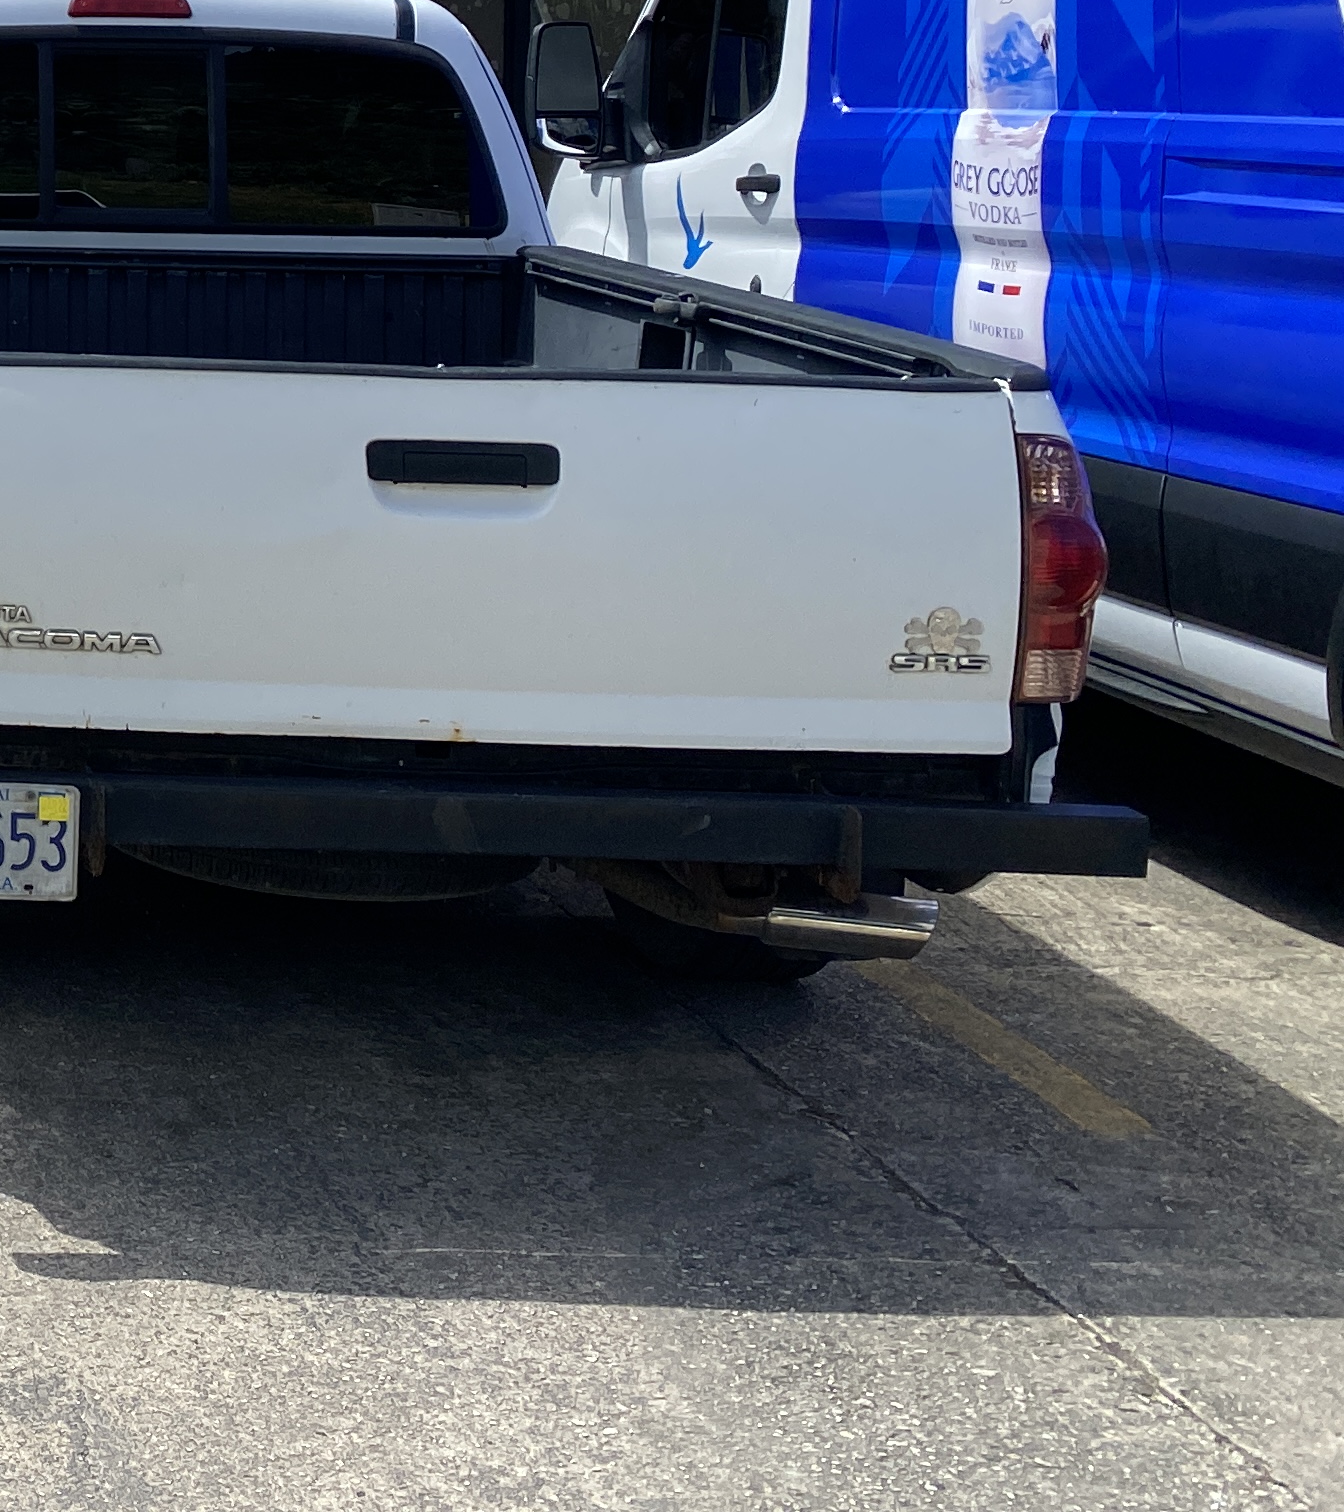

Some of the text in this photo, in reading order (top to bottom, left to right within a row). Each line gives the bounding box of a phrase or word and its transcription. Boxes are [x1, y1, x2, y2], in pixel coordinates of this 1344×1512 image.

[953, 159, 1040, 197] GREY GOOSE
[968, 200, 1022, 225] VODKA
[968, 318, 1024, 341] IMPORTED
